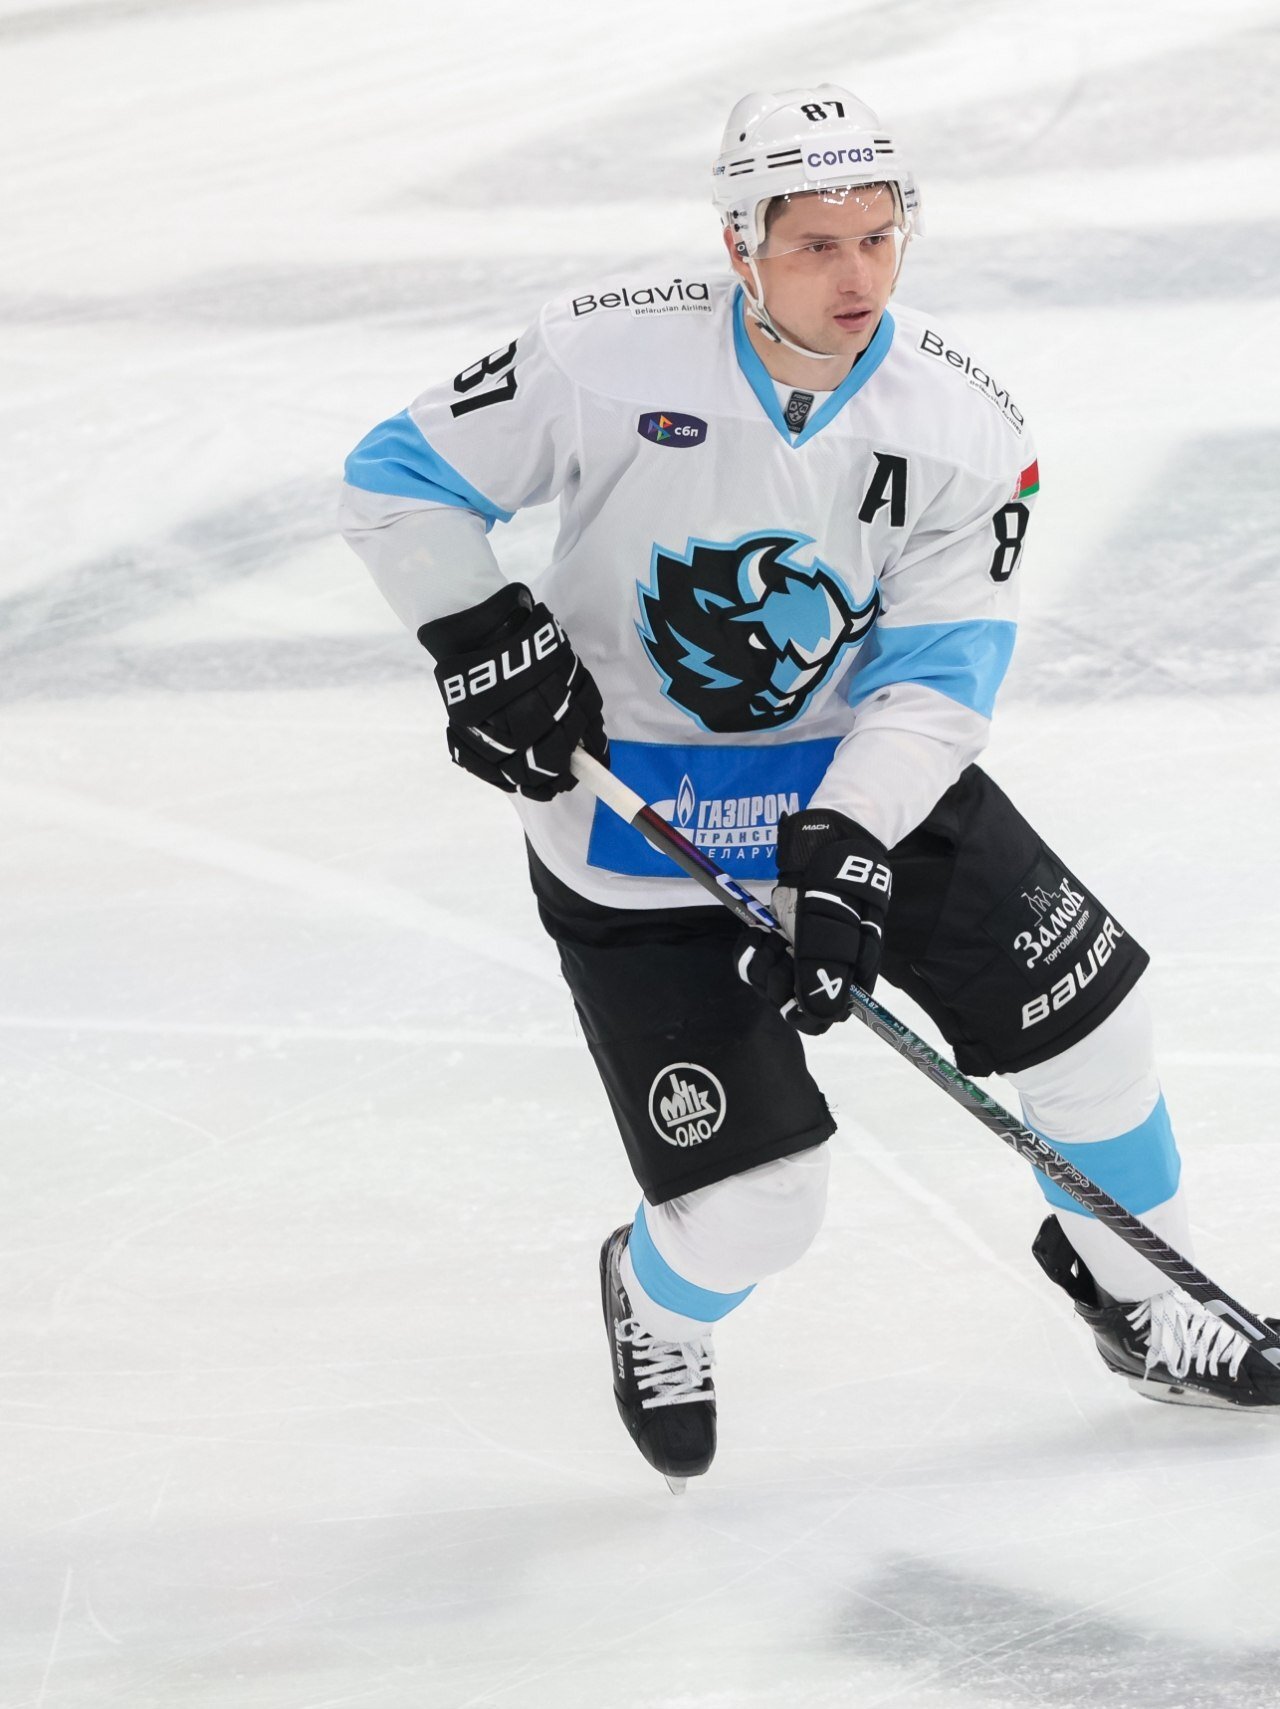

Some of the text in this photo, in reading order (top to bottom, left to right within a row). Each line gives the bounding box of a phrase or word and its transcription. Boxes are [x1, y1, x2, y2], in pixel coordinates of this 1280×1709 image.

[800, 101, 845, 122] 87
[807, 147, 874, 168] согаз
[572, 278, 710, 317] Belavia
[635, 304, 712, 315] Belarusian Airlines
[449, 337, 518, 418] 87
[920, 329, 1024, 426] Belavia
[857, 451, 907, 527] A
[989, 502, 1030, 583] 8
[697, 792, 800, 829] ГАЗПРОМ
[698, 846, 777, 860] ЕЛАРУ
[700, 829, 773, 845] ТРАНСГ
[715, 873, 775, 927] CC
